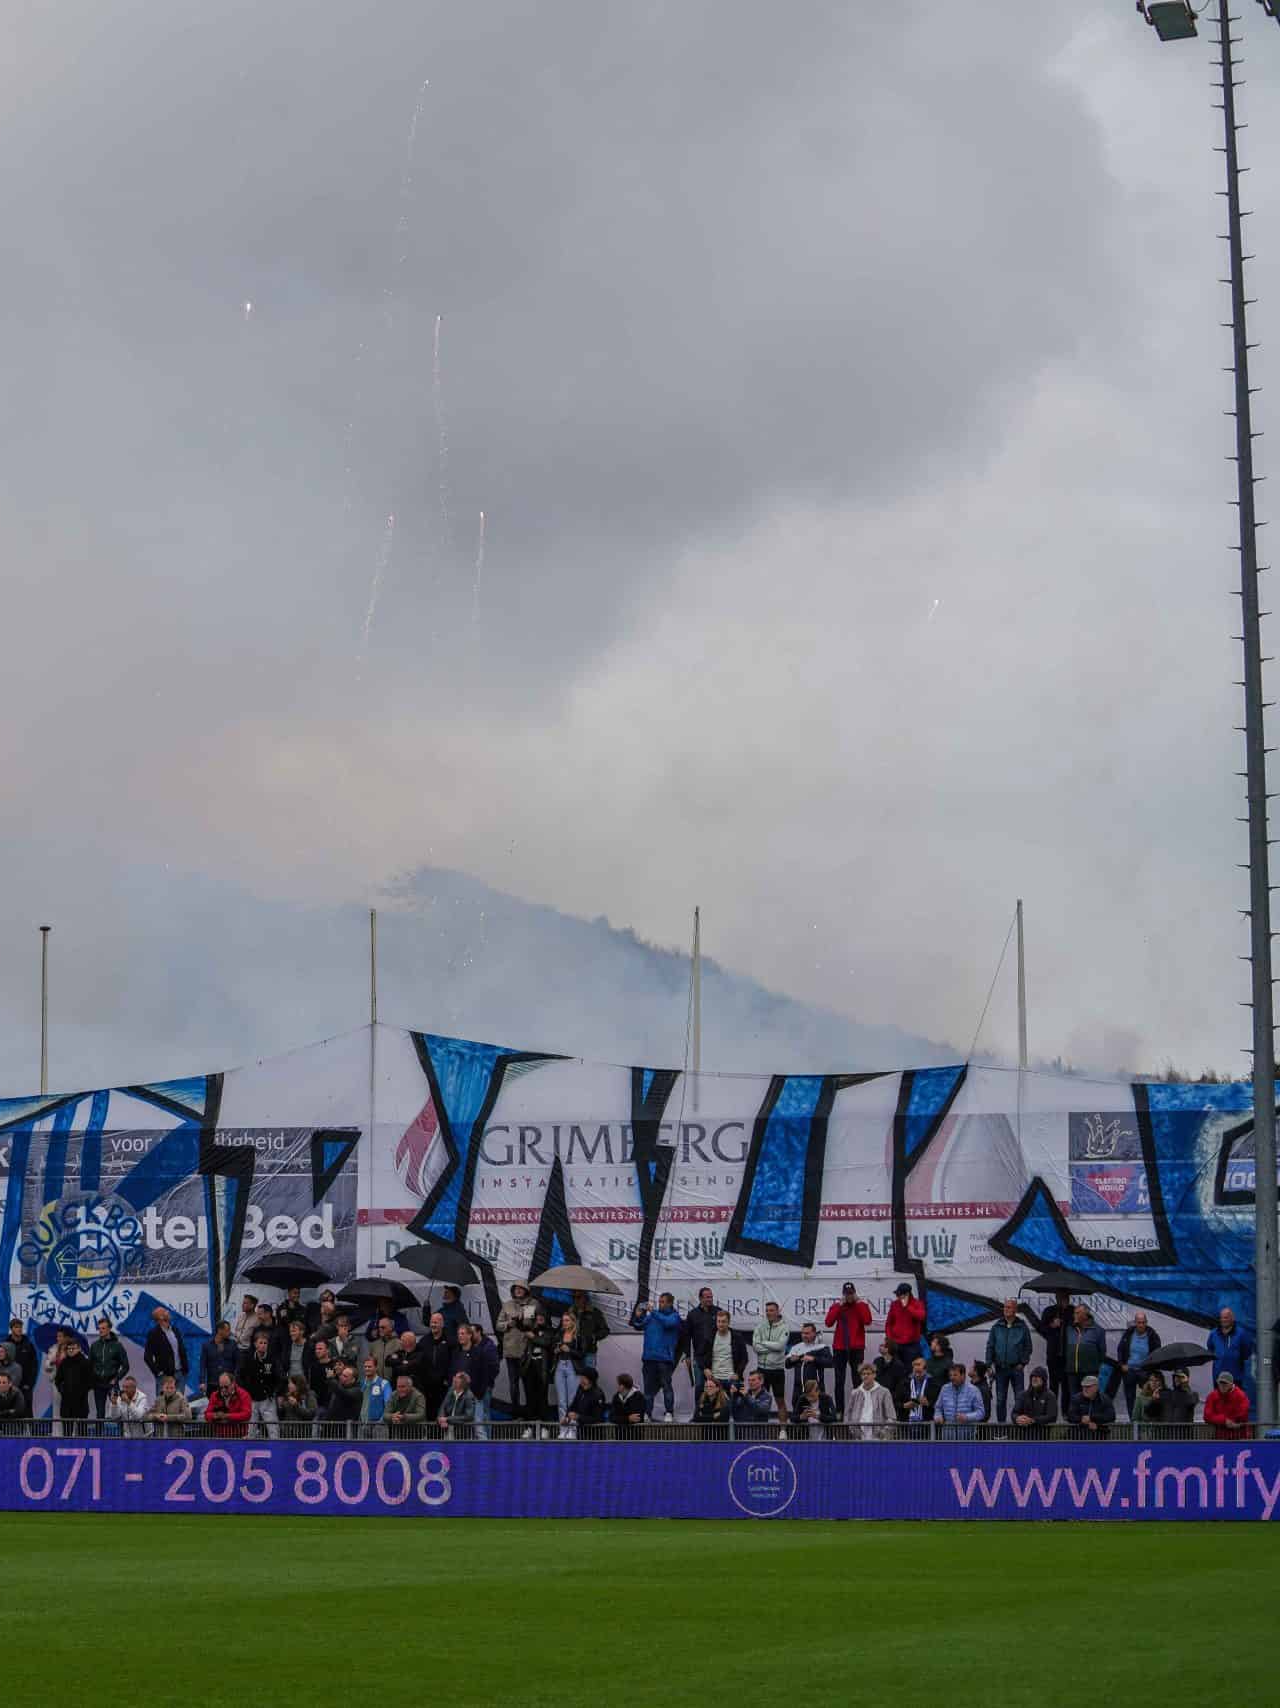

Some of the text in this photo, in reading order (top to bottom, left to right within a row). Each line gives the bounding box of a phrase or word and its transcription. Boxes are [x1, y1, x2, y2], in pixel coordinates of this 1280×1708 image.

[111, 1138, 152, 1152] voor
[241, 1203, 335, 1250] Bed
[19, 1446, 102, 1501] 071
[163, 1448, 273, 1503] 205
[293, 1450, 453, 1505] 8008
[747, 1464, 780, 1483] fmt
